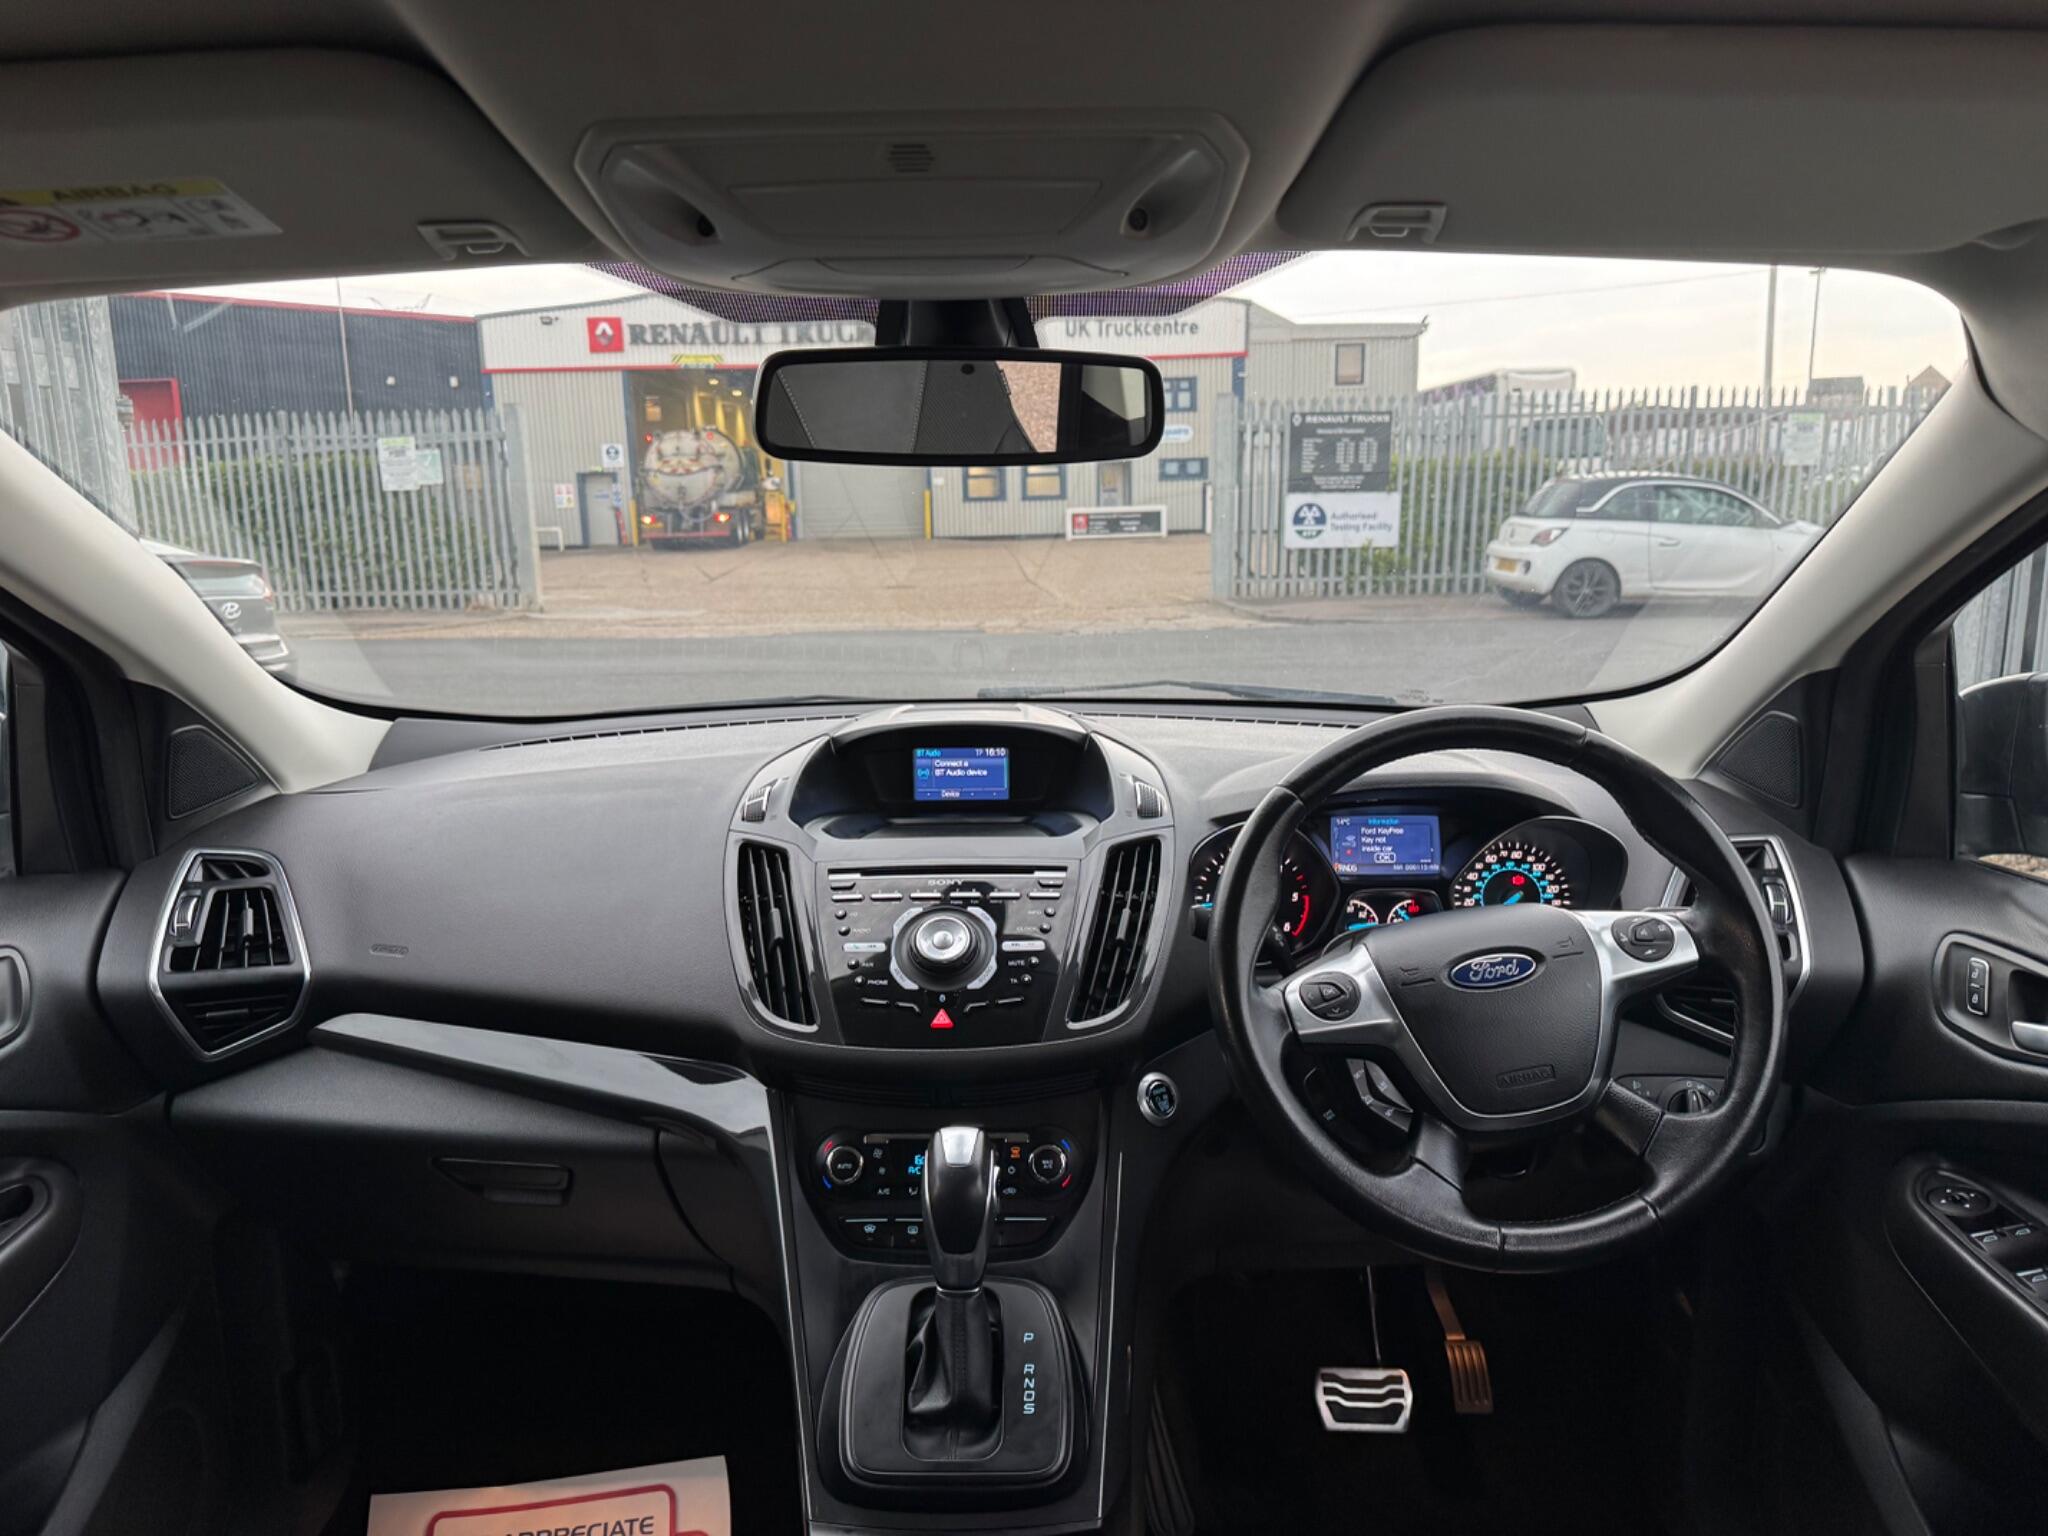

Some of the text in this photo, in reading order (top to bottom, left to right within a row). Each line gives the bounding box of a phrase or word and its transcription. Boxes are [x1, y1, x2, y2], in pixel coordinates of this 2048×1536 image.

[627, 321, 762, 346] RENAULT
[1065, 318, 1199, 337] UK Truckcentre
[934, 759, 962, 768] Connect
[934, 768, 988, 777] BT Audio device
[941, 789, 960, 798] Device
[1360, 827, 1376, 835] Ford
[1466, 872, 1479, 880] 40
[1469, 957, 1520, 981] Ford
[1023, 1332, 1034, 1344] P
[1023, 1363, 1035, 1375] R
[1023, 1377, 1035, 1389] N
[1023, 1403, 1035, 1415] S
